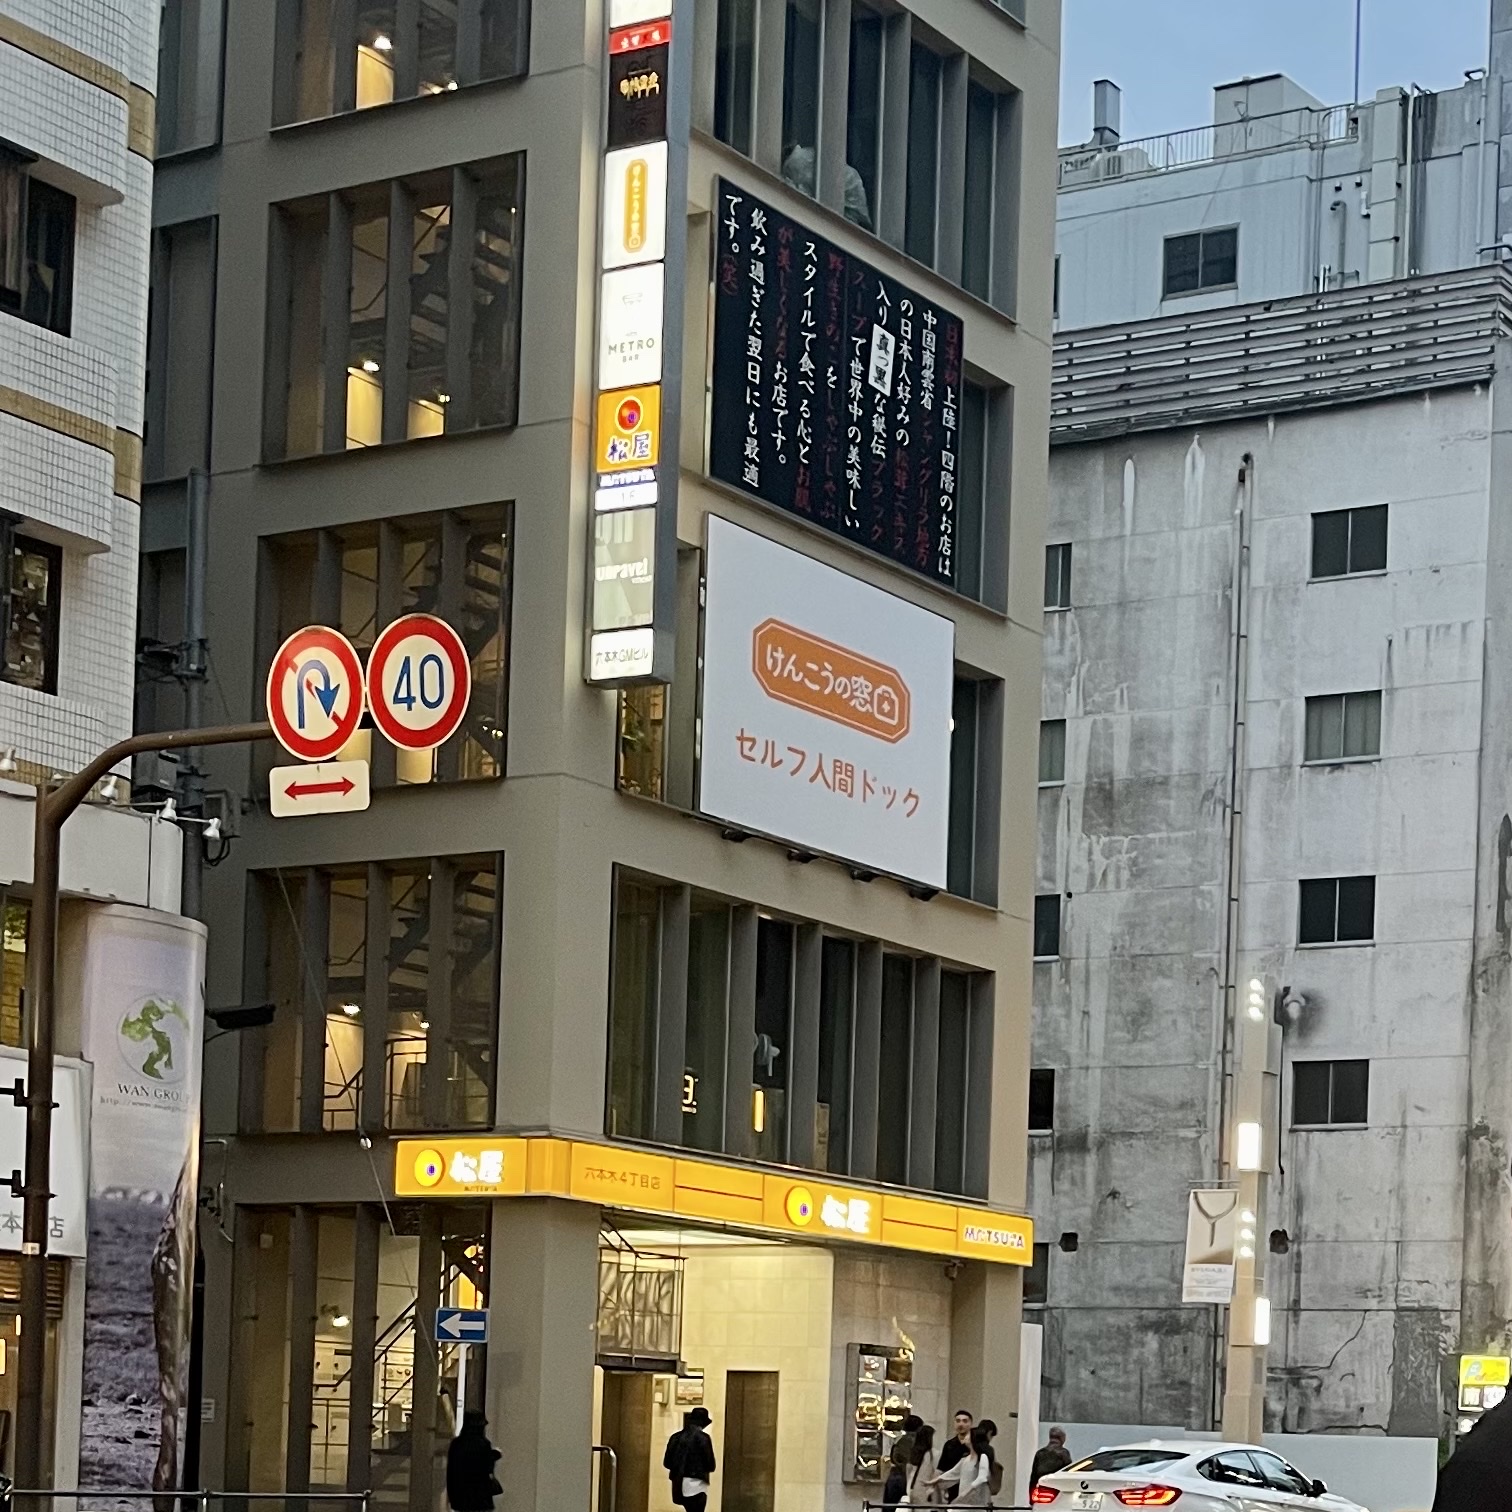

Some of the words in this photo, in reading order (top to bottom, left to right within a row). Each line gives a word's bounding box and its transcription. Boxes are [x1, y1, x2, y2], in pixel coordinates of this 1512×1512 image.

[608, 338, 655, 355] METRO
[606, 432, 650, 461] 松屋
[393, 654, 445, 711] 40
[767, 643, 872, 714] けんこうの窓
[736, 728, 921, 818] セルフ人間ドック
[118, 1083, 149, 1097] WAN
[584, 1167, 661, 1190] 六本木4丁目店
